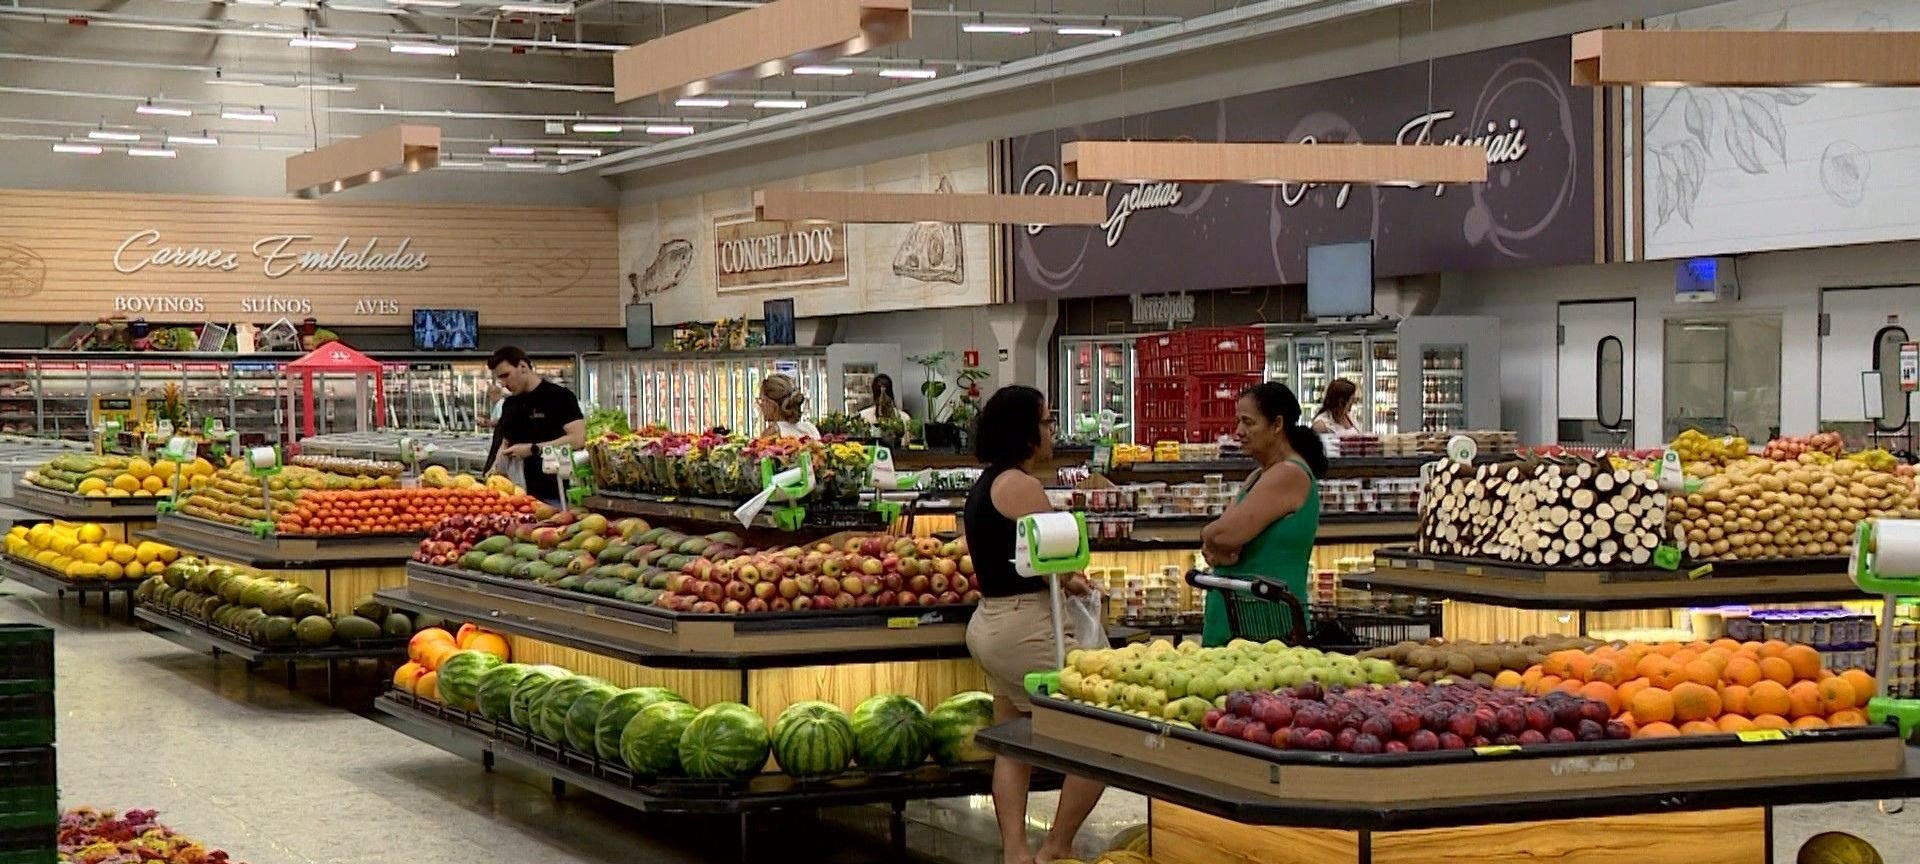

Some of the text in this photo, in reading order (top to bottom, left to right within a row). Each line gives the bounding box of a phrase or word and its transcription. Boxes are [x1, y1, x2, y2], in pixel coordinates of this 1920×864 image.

[113, 229, 429, 278] Carnes Embaladas
[721, 226, 833, 273] CONGELADOS
[113, 296, 399, 314] BOVINOS SUÍNOS AVES
